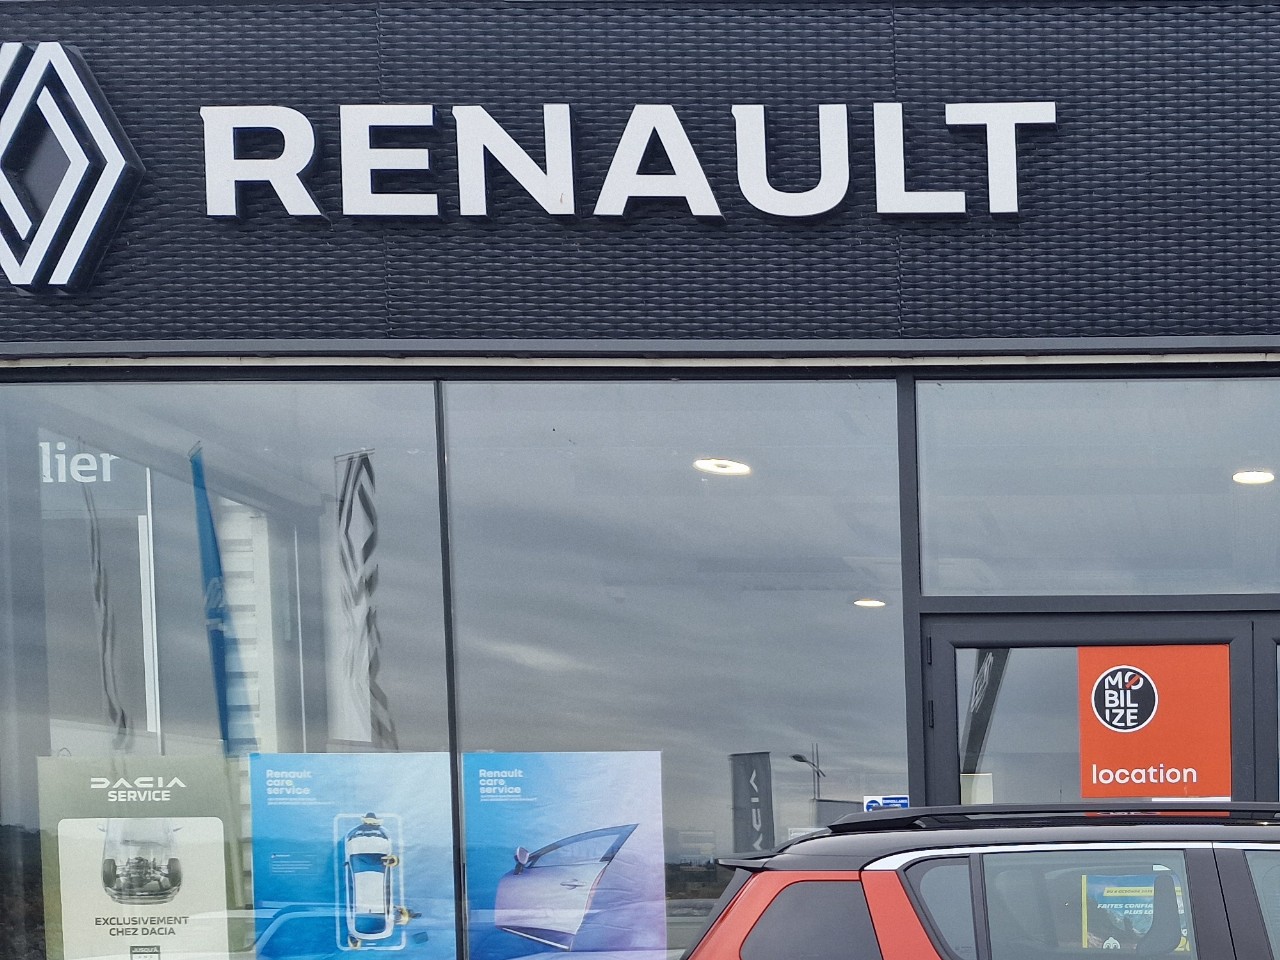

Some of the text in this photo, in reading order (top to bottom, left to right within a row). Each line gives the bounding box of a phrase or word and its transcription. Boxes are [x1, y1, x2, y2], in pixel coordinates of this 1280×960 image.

[199, 101, 1057, 218] RENAULT
[266, 769, 312, 778] Renault
[479, 769, 524, 778] Renault
[1092, 763, 1198, 785] location
[90, 776, 187, 789] DACIA
[266, 779, 294, 787] care
[479, 778, 505, 786] care
[267, 786, 311, 795] service
[479, 785, 521, 794] service
[107, 790, 171, 802] SERVICE
[95, 916, 189, 926] EXCLUSIVEMENT
[109, 927, 176, 936] CHEZ DACIA
